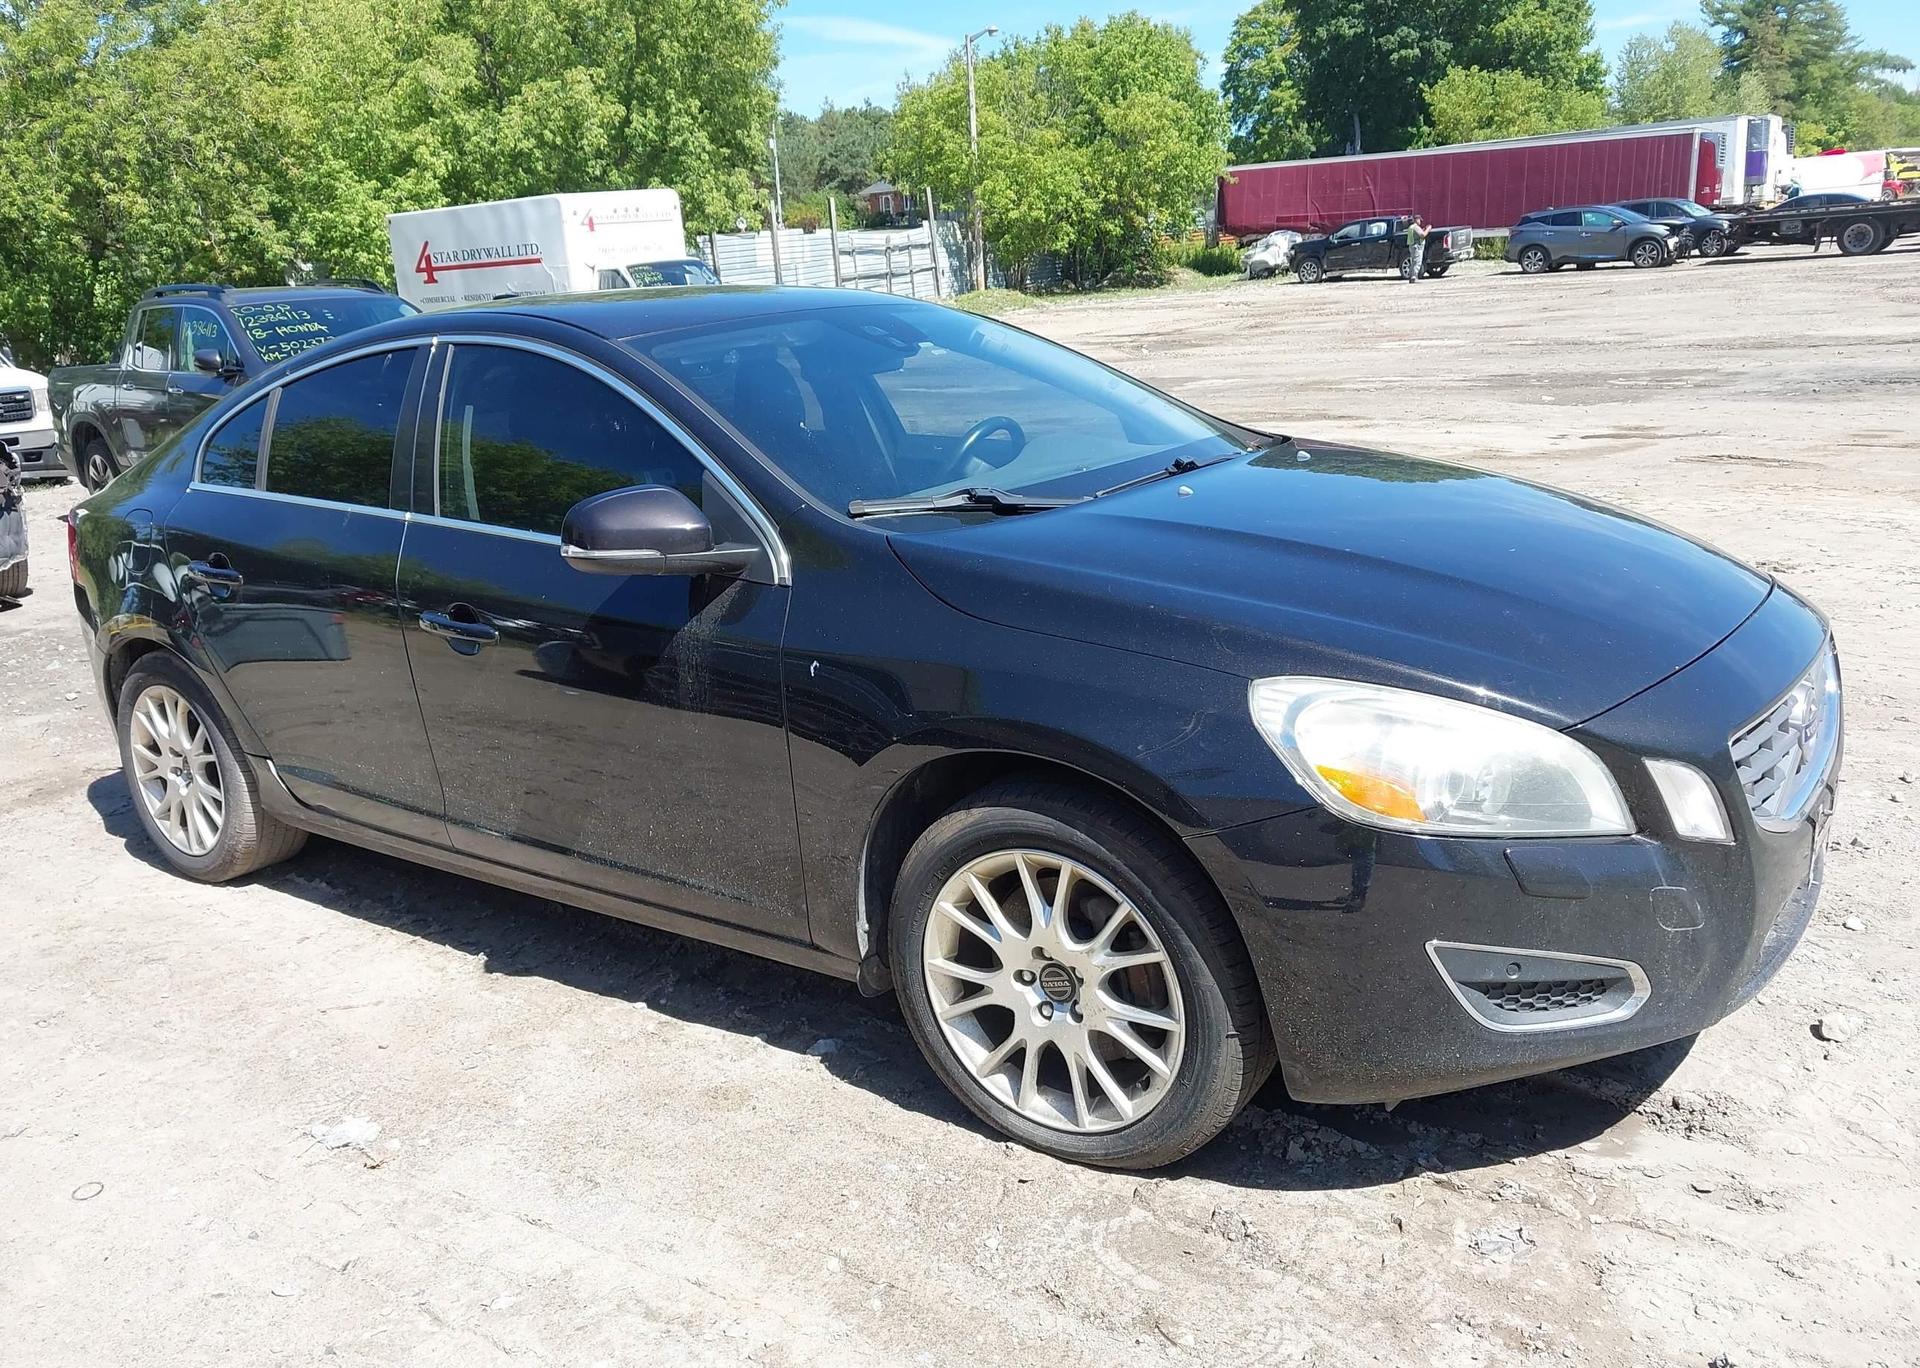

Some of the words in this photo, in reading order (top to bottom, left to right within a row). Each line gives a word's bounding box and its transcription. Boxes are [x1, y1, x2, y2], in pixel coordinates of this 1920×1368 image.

[415, 240, 439, 285] 4
[432, 250, 461, 264] STAR
[462, 245, 515, 263] DRYWALL
[516, 243, 543, 257] LTD.
